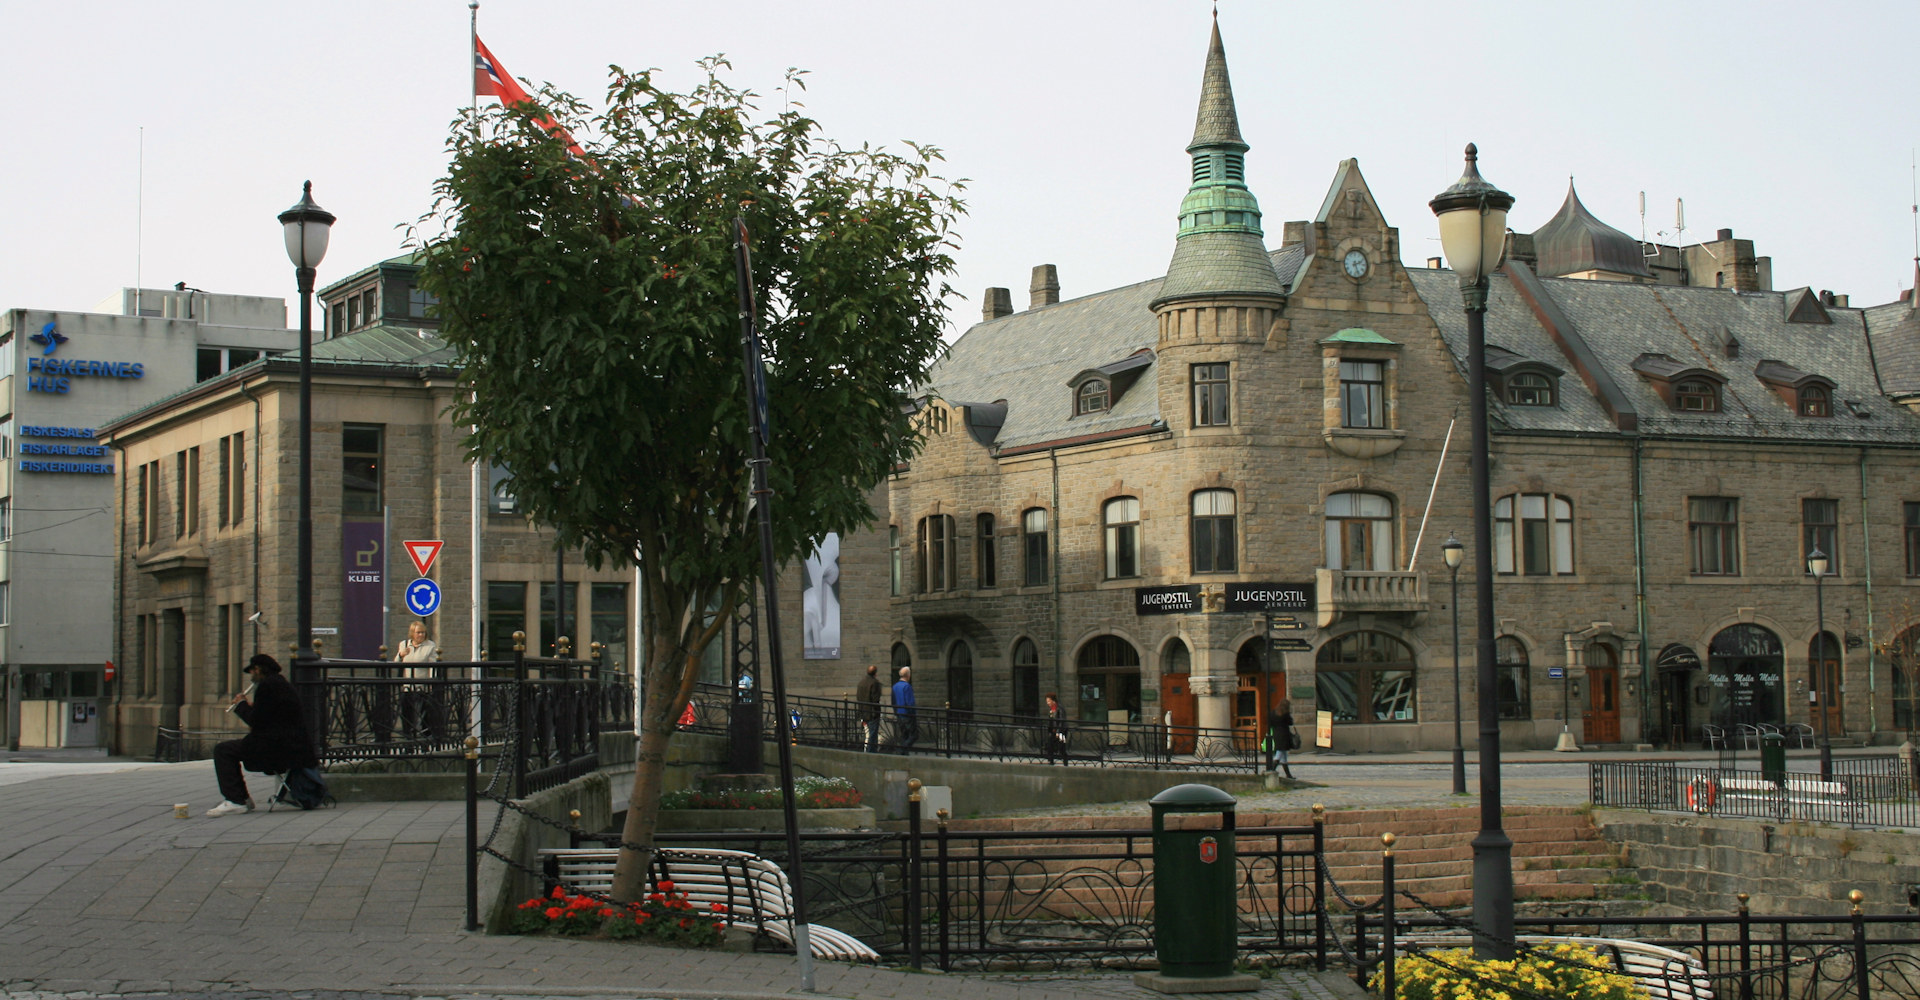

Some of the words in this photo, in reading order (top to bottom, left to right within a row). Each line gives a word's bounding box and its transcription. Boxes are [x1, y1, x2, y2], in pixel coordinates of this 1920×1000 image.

[27, 357, 145, 379] FISKERNES
[27, 375, 71, 394] HUS
[20, 443, 110, 456] FISKARLAGET
[348, 575, 380, 583] KUBE
[1142, 592, 1193, 605] JUGENDSTIL
[1234, 590, 1307, 602] JUGENDSTIL
[1161, 603, 1193, 611] SENTERET
